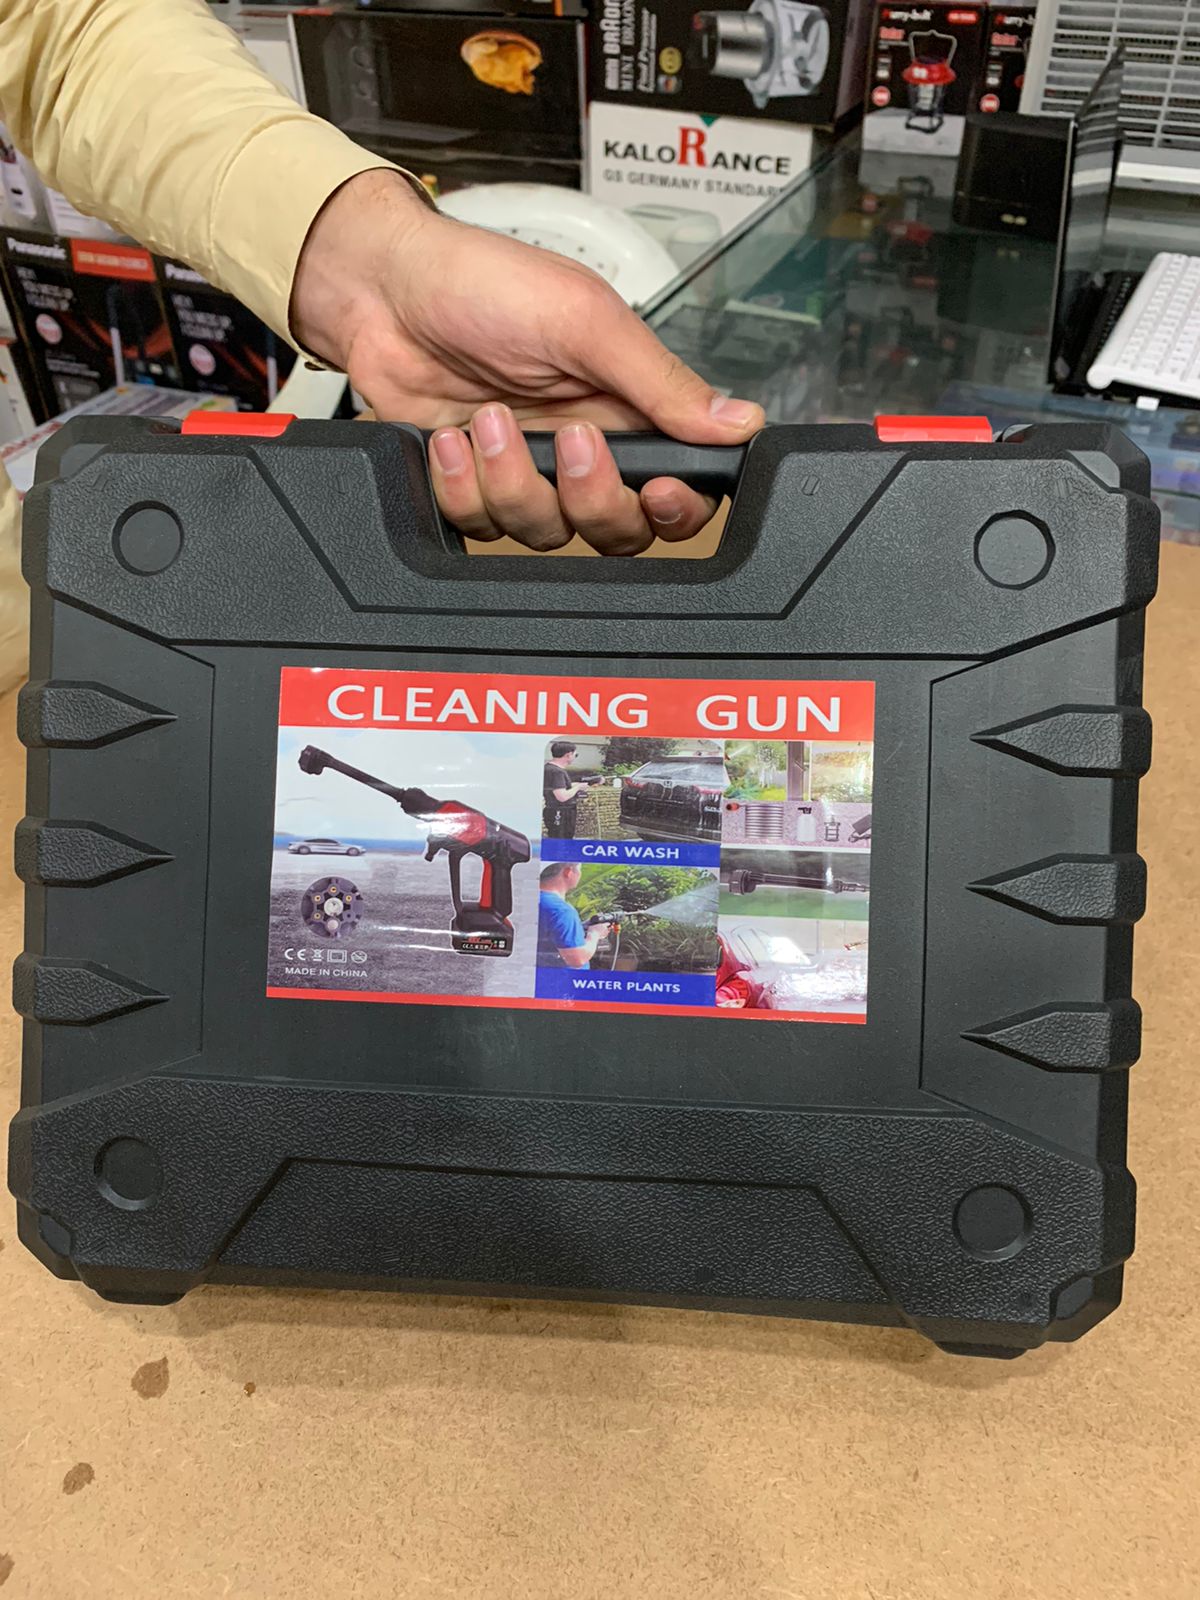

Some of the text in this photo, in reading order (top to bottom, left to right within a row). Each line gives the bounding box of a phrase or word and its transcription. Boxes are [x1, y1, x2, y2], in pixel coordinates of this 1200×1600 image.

[603, 126, 792, 176] KALORANCE
[603, 168, 623, 183] GS
[627, 172, 700, 191] GERMANY
[327, 684, 841, 733] CLEANING GUN
[581, 845, 680, 859] CAR WASH
[285, 967, 368, 978] MADE IN CHINA
[572, 979, 681, 993] WATER PLANTS
